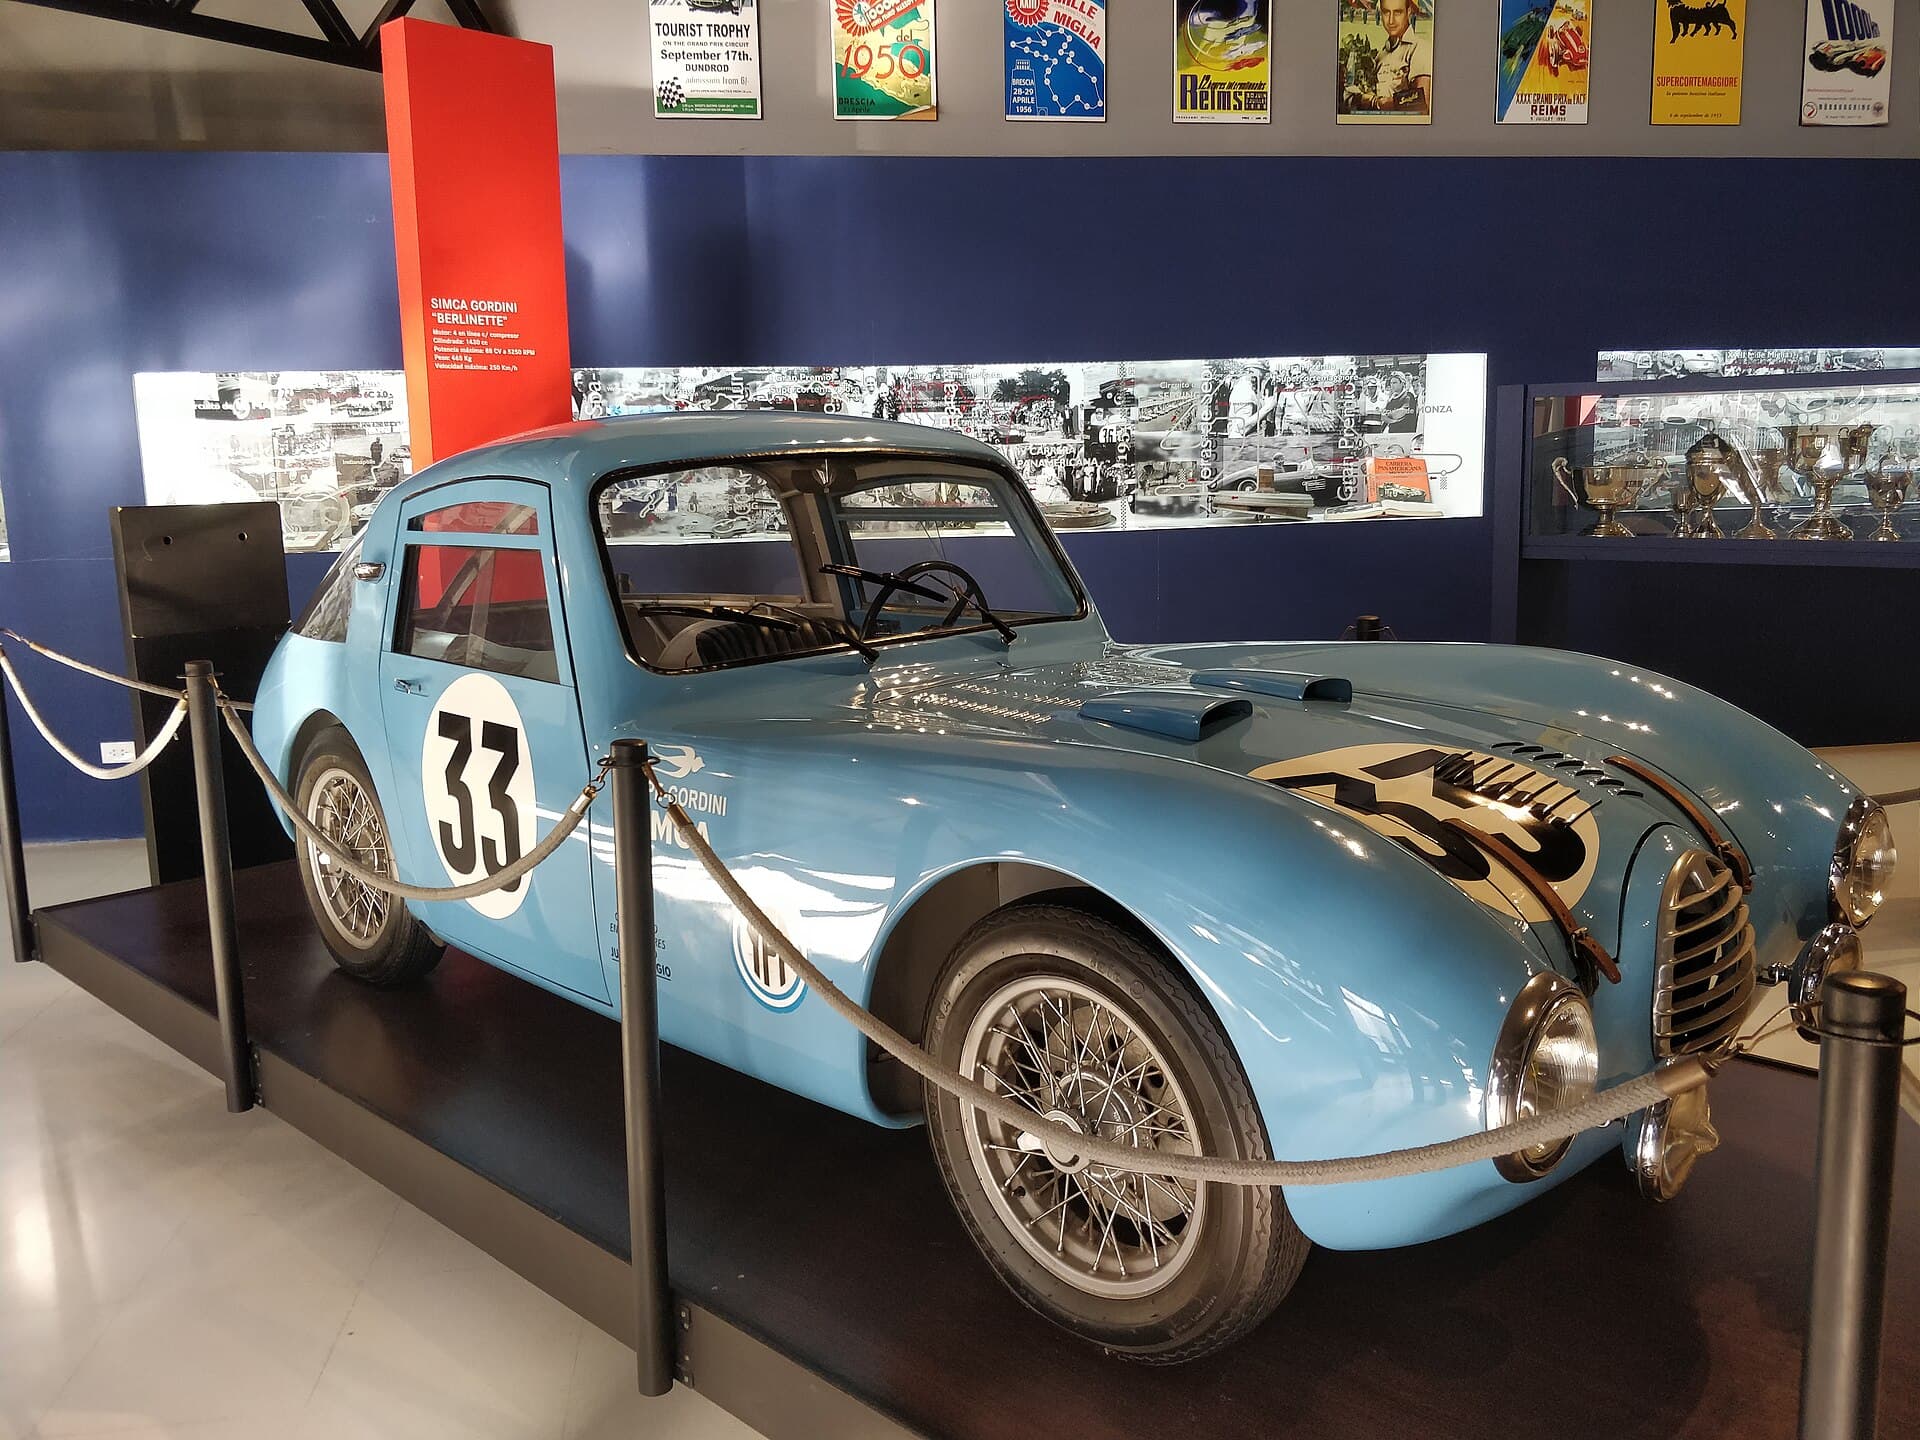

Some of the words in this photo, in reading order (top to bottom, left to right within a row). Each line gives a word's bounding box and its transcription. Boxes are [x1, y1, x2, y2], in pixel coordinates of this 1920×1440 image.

[655, 22, 702, 37] TOURIST
[706, 23, 750, 38] TROPHY
[896, 29, 912, 42] del
[1053, 11, 1101, 49] MIGLIA
[660, 49, 721, 62] September
[725, 50, 752, 61] 17th.
[685, 64, 729, 72] DUNDROD
[841, 45, 924, 79] 1950
[722, 76, 739, 85] from
[1012, 78, 1034, 86] BRESCIA
[1656, 76, 1739, 88] SUPERCORTEMAGGIORE
[1180, 74, 1243, 110] Reims
[838, 97, 876, 106] BRESCIA
[1012, 96, 1035, 104] APRILE
[1533, 94, 1552, 104] GRAND
[1530, 104, 1566, 116] REIMS
[431, 297, 468, 311] SIMCA
[470, 299, 518, 313] GORDINI
[431, 311, 508, 327] "BERLINETTE"
[432, 328, 452, 336] Motor:
[489, 332, 519, 340] compresor
[433, 345, 459, 353] Potencia
[1017, 457, 1098, 469] PANAMERICANA
[438, 711, 521, 892] 33
[668, 785, 728, 817] GORDINI
[1262, 749, 1586, 883] 33
